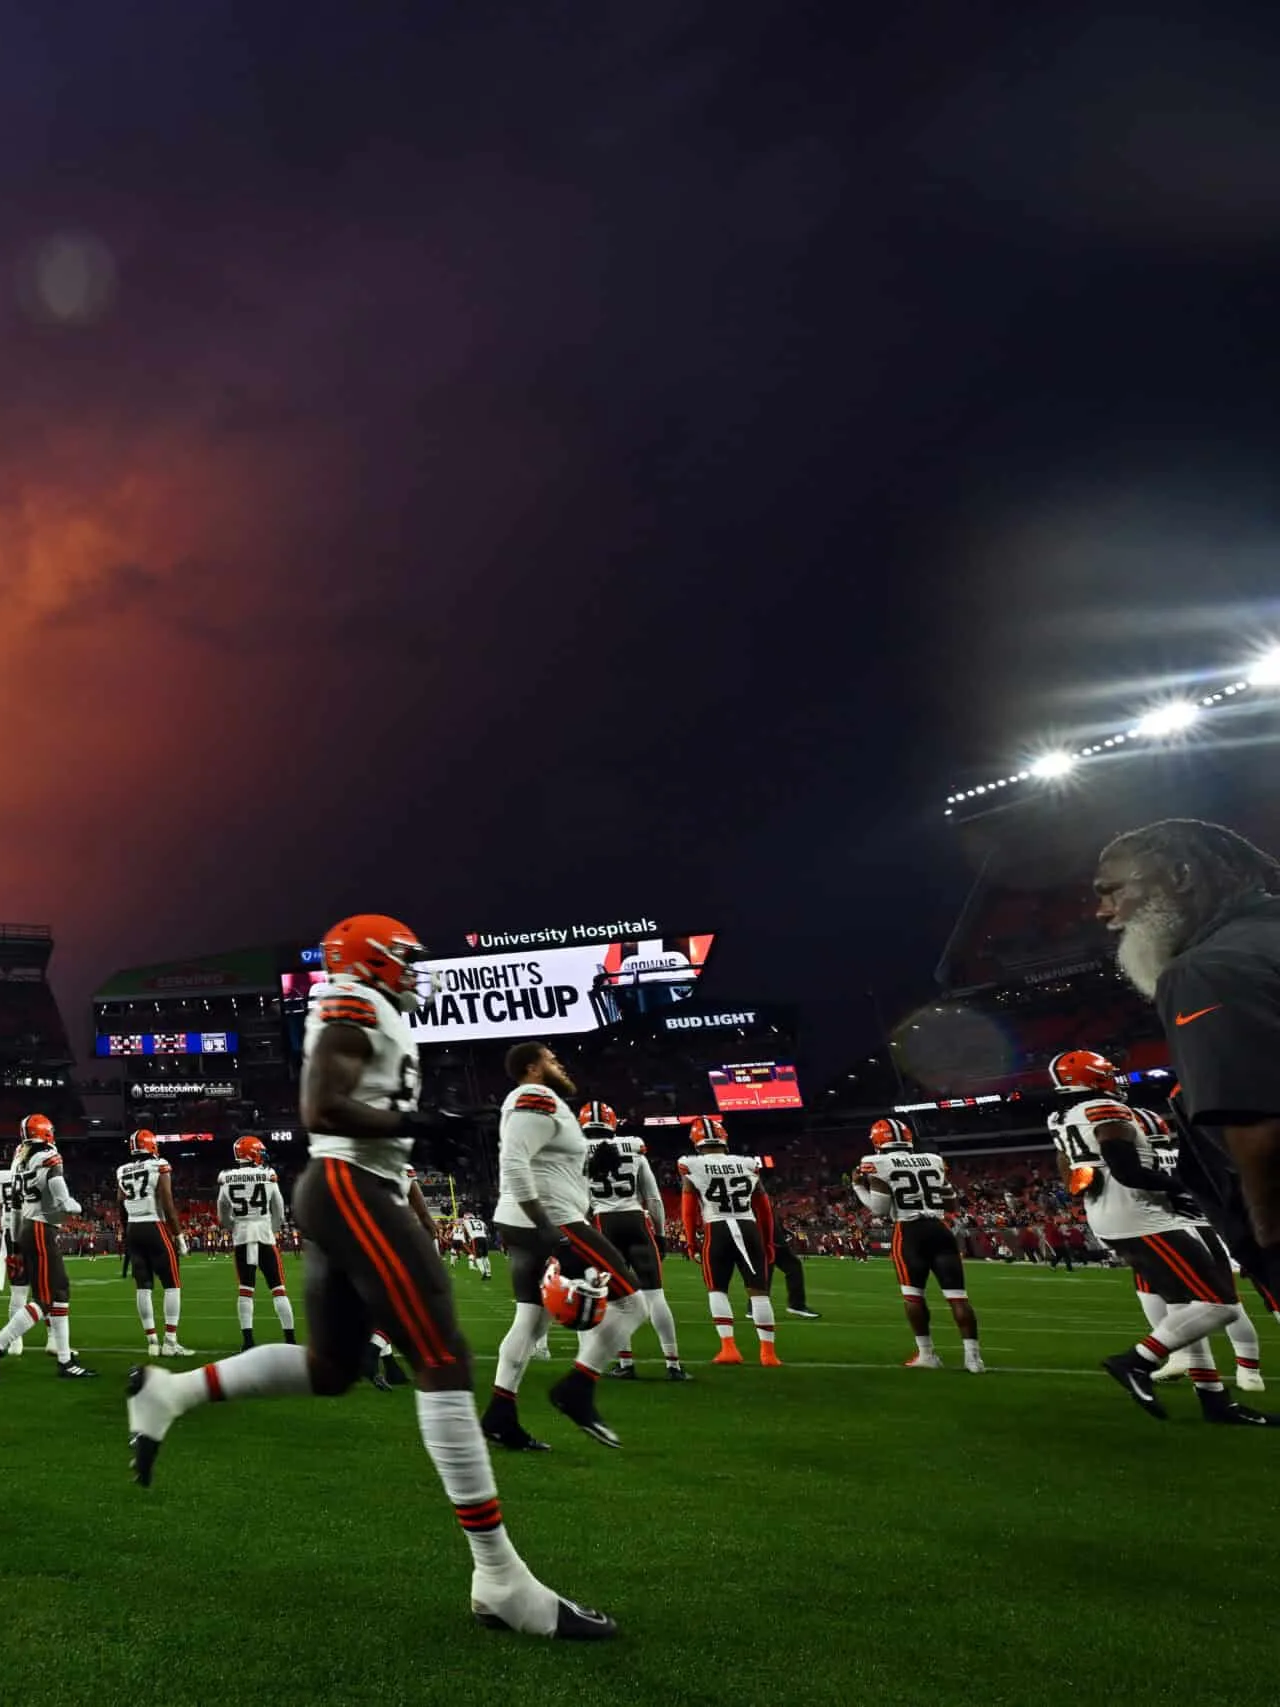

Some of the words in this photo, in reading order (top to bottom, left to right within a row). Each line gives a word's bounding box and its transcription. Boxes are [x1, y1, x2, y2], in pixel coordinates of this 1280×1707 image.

[480, 926, 568, 949] University
[572, 917, 658, 941] Hospitals
[409, 985, 579, 1029] MATCHUP
[665, 1015, 702, 1030] BUD
[704, 1011, 757, 1027] LIGHT
[121, 1169, 149, 1200] 57
[704, 1164, 735, 1175] FIELDS
[736, 1164, 744, 1174] II
[228, 1183, 267, 1217] 54
[705, 1175, 752, 1213] 42
[890, 1169, 944, 1210] 26
